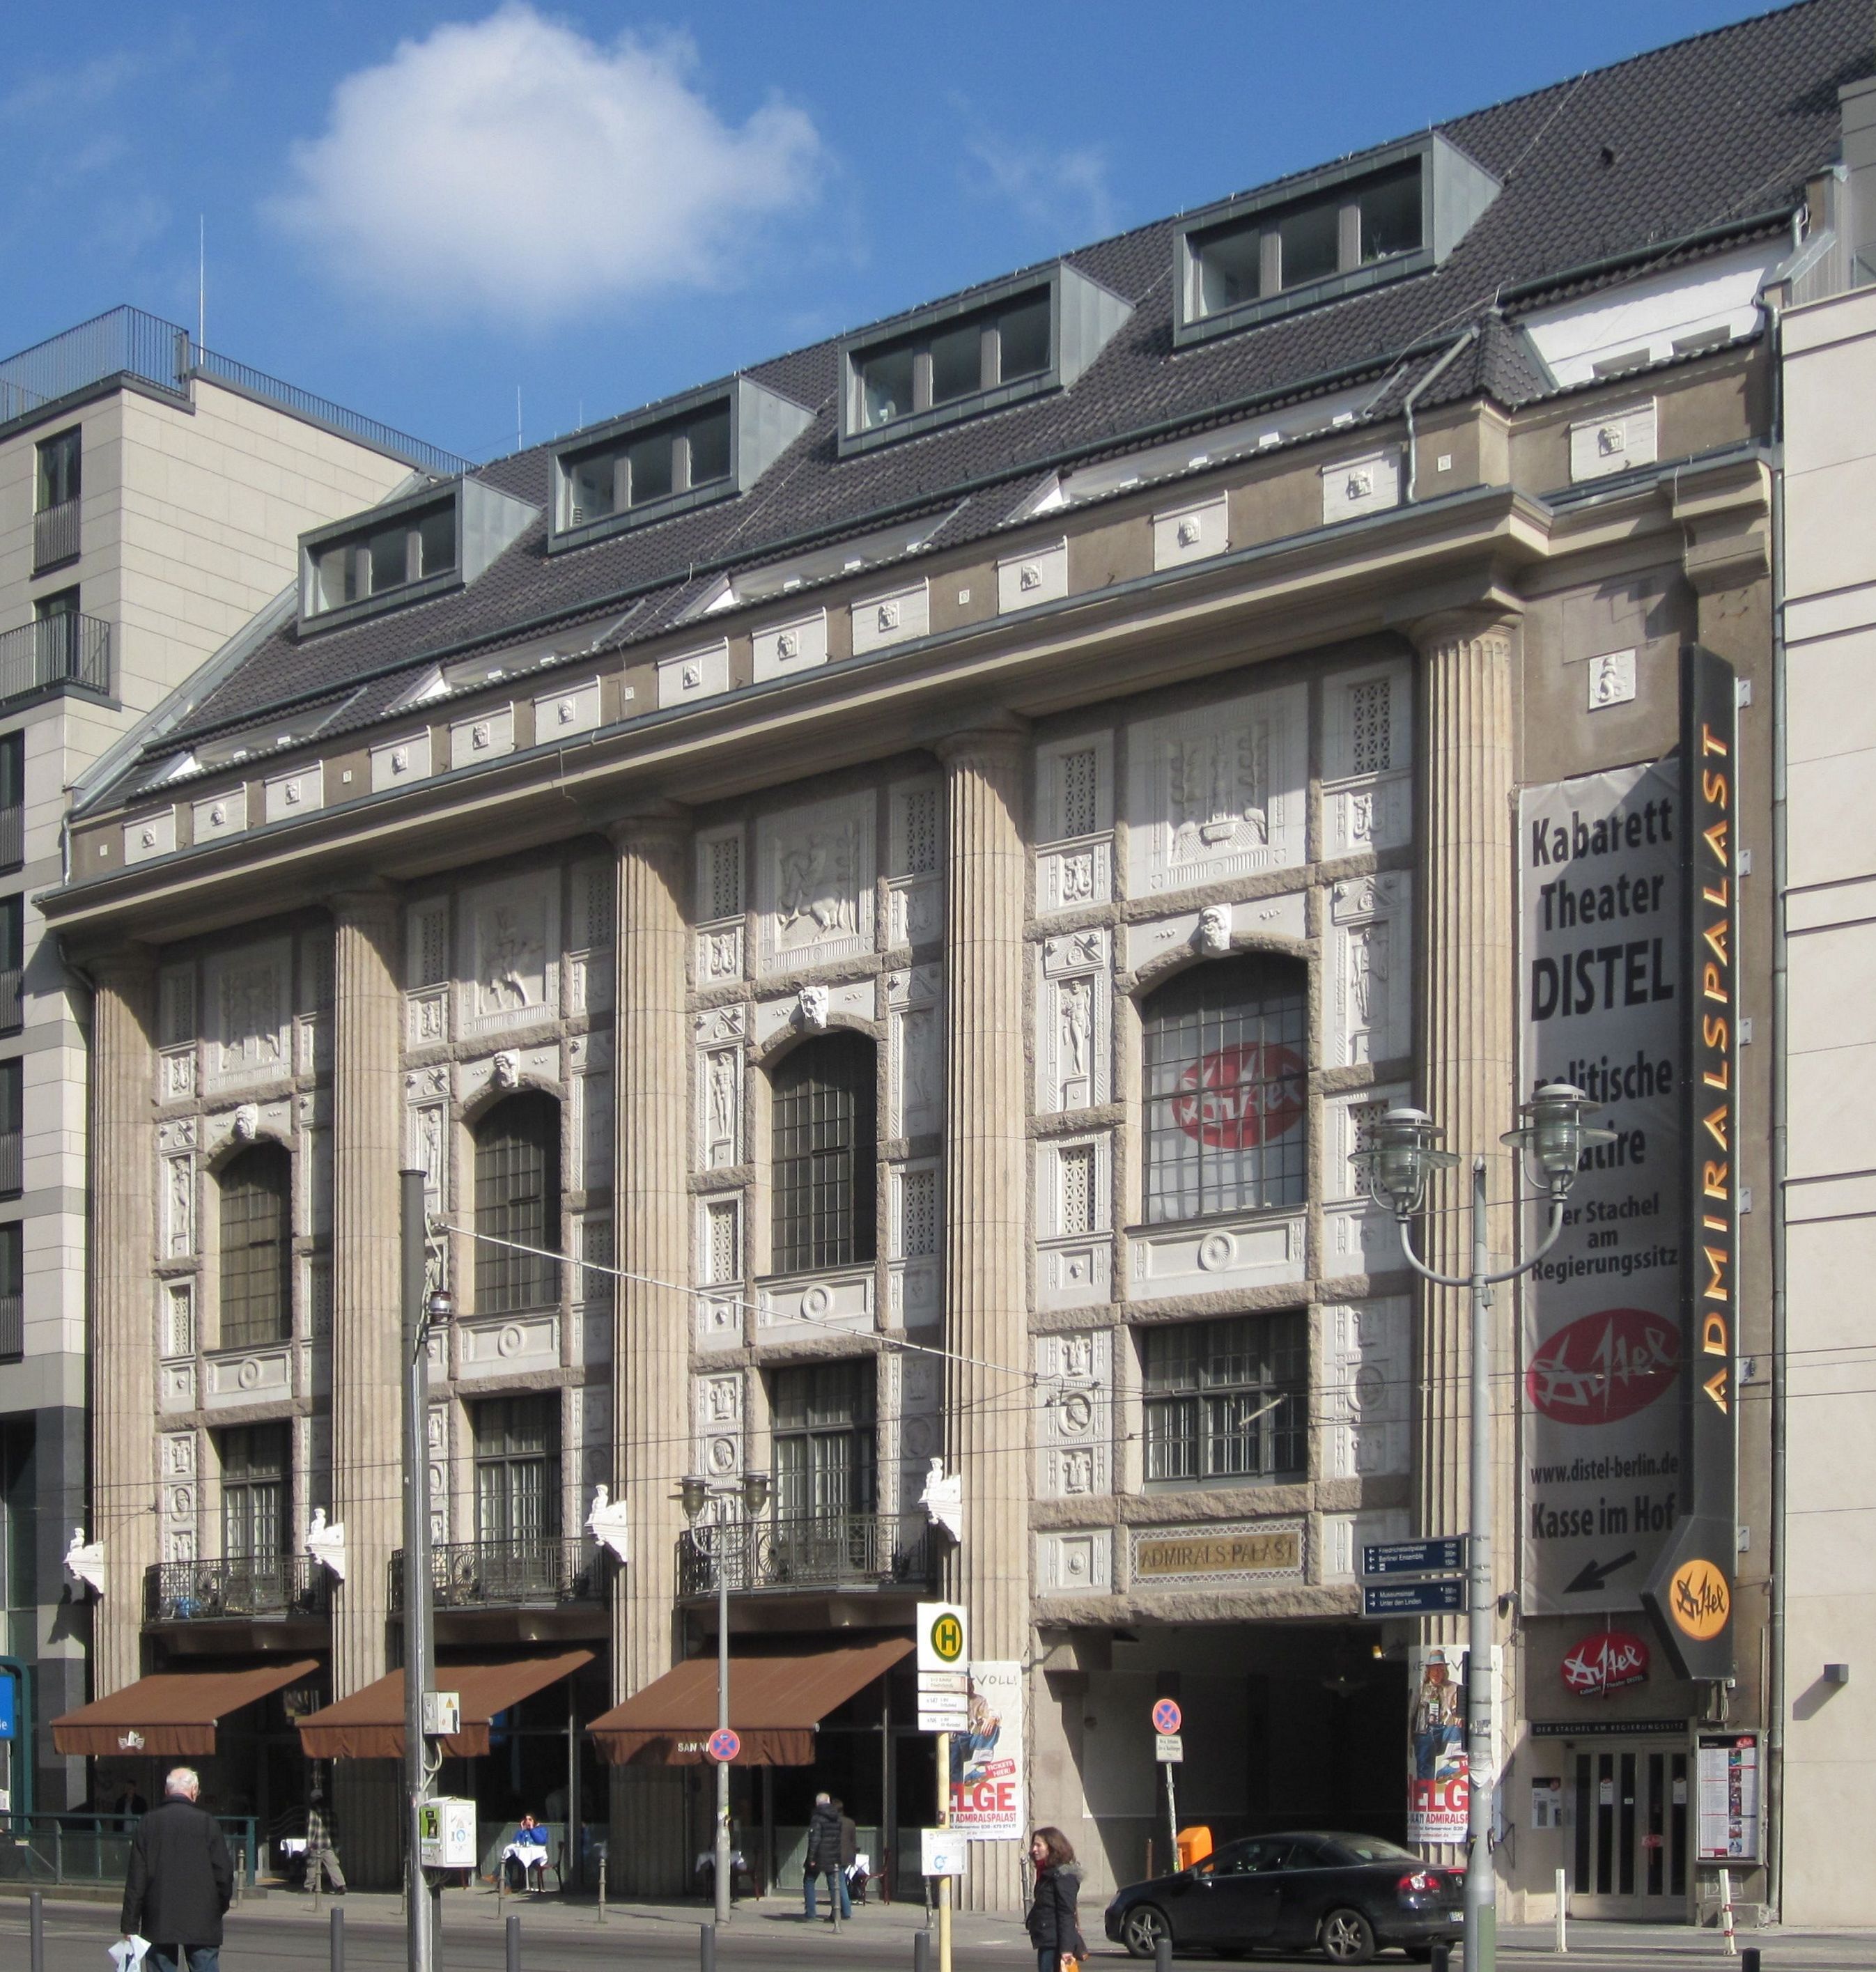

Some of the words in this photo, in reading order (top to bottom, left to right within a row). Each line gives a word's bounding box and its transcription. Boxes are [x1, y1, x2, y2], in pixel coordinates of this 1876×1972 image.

[1533, 798, 1672, 867] Kabarett
[1540, 874, 1664, 931] Theater
[1531, 938, 1674, 1022] DISTEL
[1703, 723, 1728, 1415] ADMIRALSPALAST
[1577, 1119, 1645, 1172] atire
[1586, 1192, 1659, 1222] Stachel
[1588, 1229, 1618, 1248] am
[1531, 1245, 1677, 1284] Regierungssitz
[1530, 1452, 1677, 1484] www.distel-berlin.de
[1532, 1503, 1593, 1539] Kasse
[1599, 1498, 1628, 1535] im
[1634, 1492, 1675, 1532] Hof
[941, 1624, 956, 1651] H
[976, 1674, 1017, 1686] VOLL!
[956, 1812, 1016, 1823] ADMIRALSPALAST
